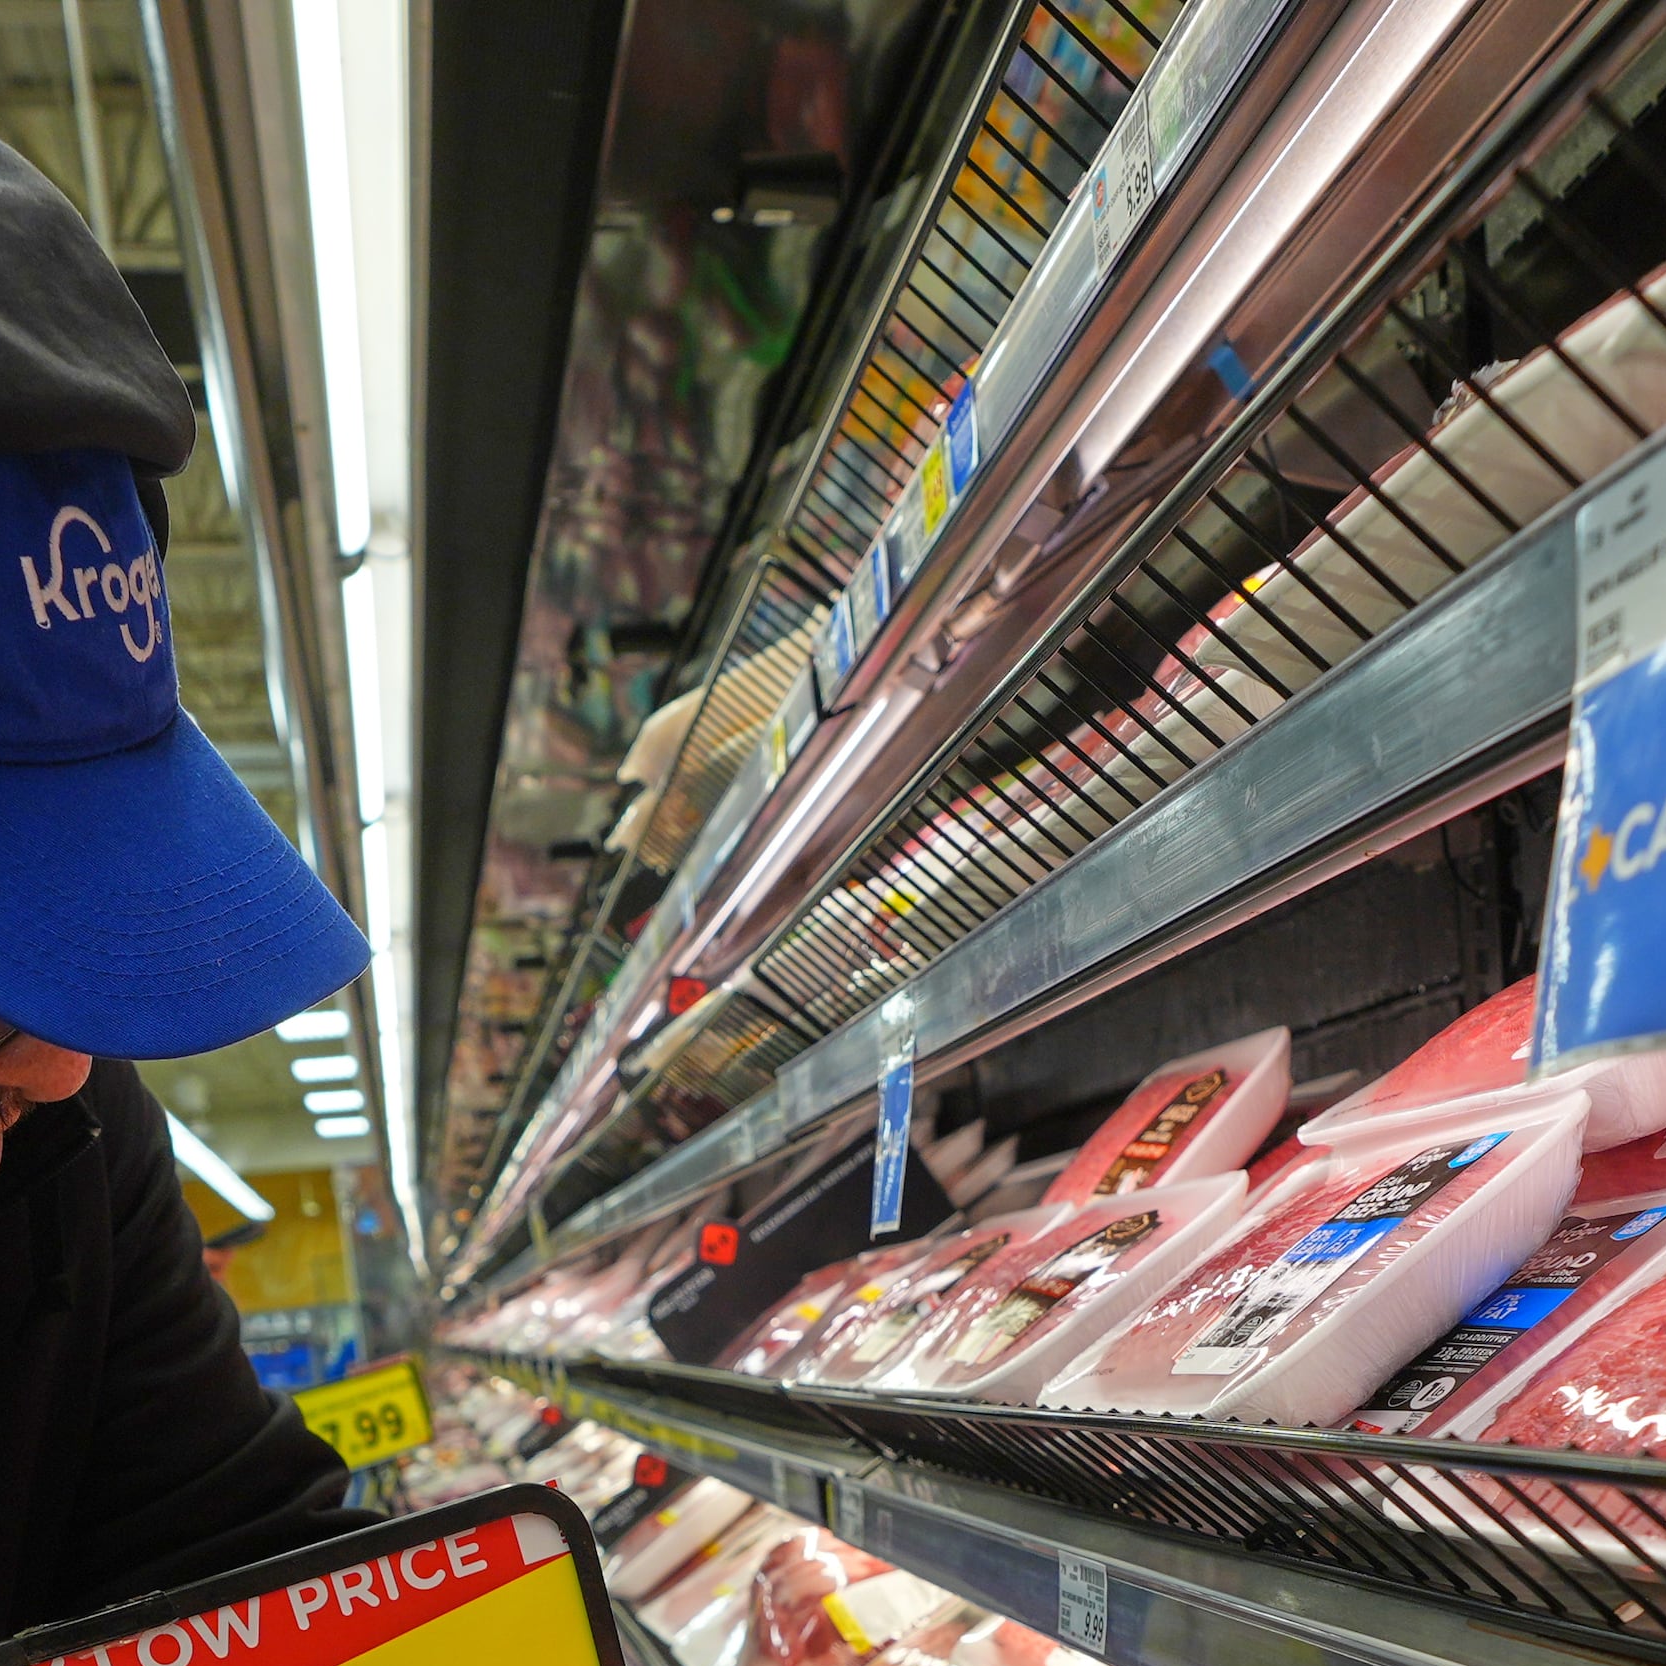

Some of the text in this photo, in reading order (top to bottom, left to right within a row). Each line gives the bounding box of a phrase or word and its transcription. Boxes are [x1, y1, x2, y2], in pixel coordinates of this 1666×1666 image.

[20, 505, 161, 663] Kroger
[1356, 1181, 1431, 1203] GROUND
[1335, 1201, 1385, 1219] BEEF
[1497, 1294, 1525, 1307] 7%
[1479, 1306, 1518, 1321] FAT
[1465, 1334, 1513, 1344] ADDITIVES
[1456, 1347, 1497, 1356] PROTEIN
[286, 1527, 488, 1631] PRICE
[1084, 1611, 1104, 1643] 9.99
